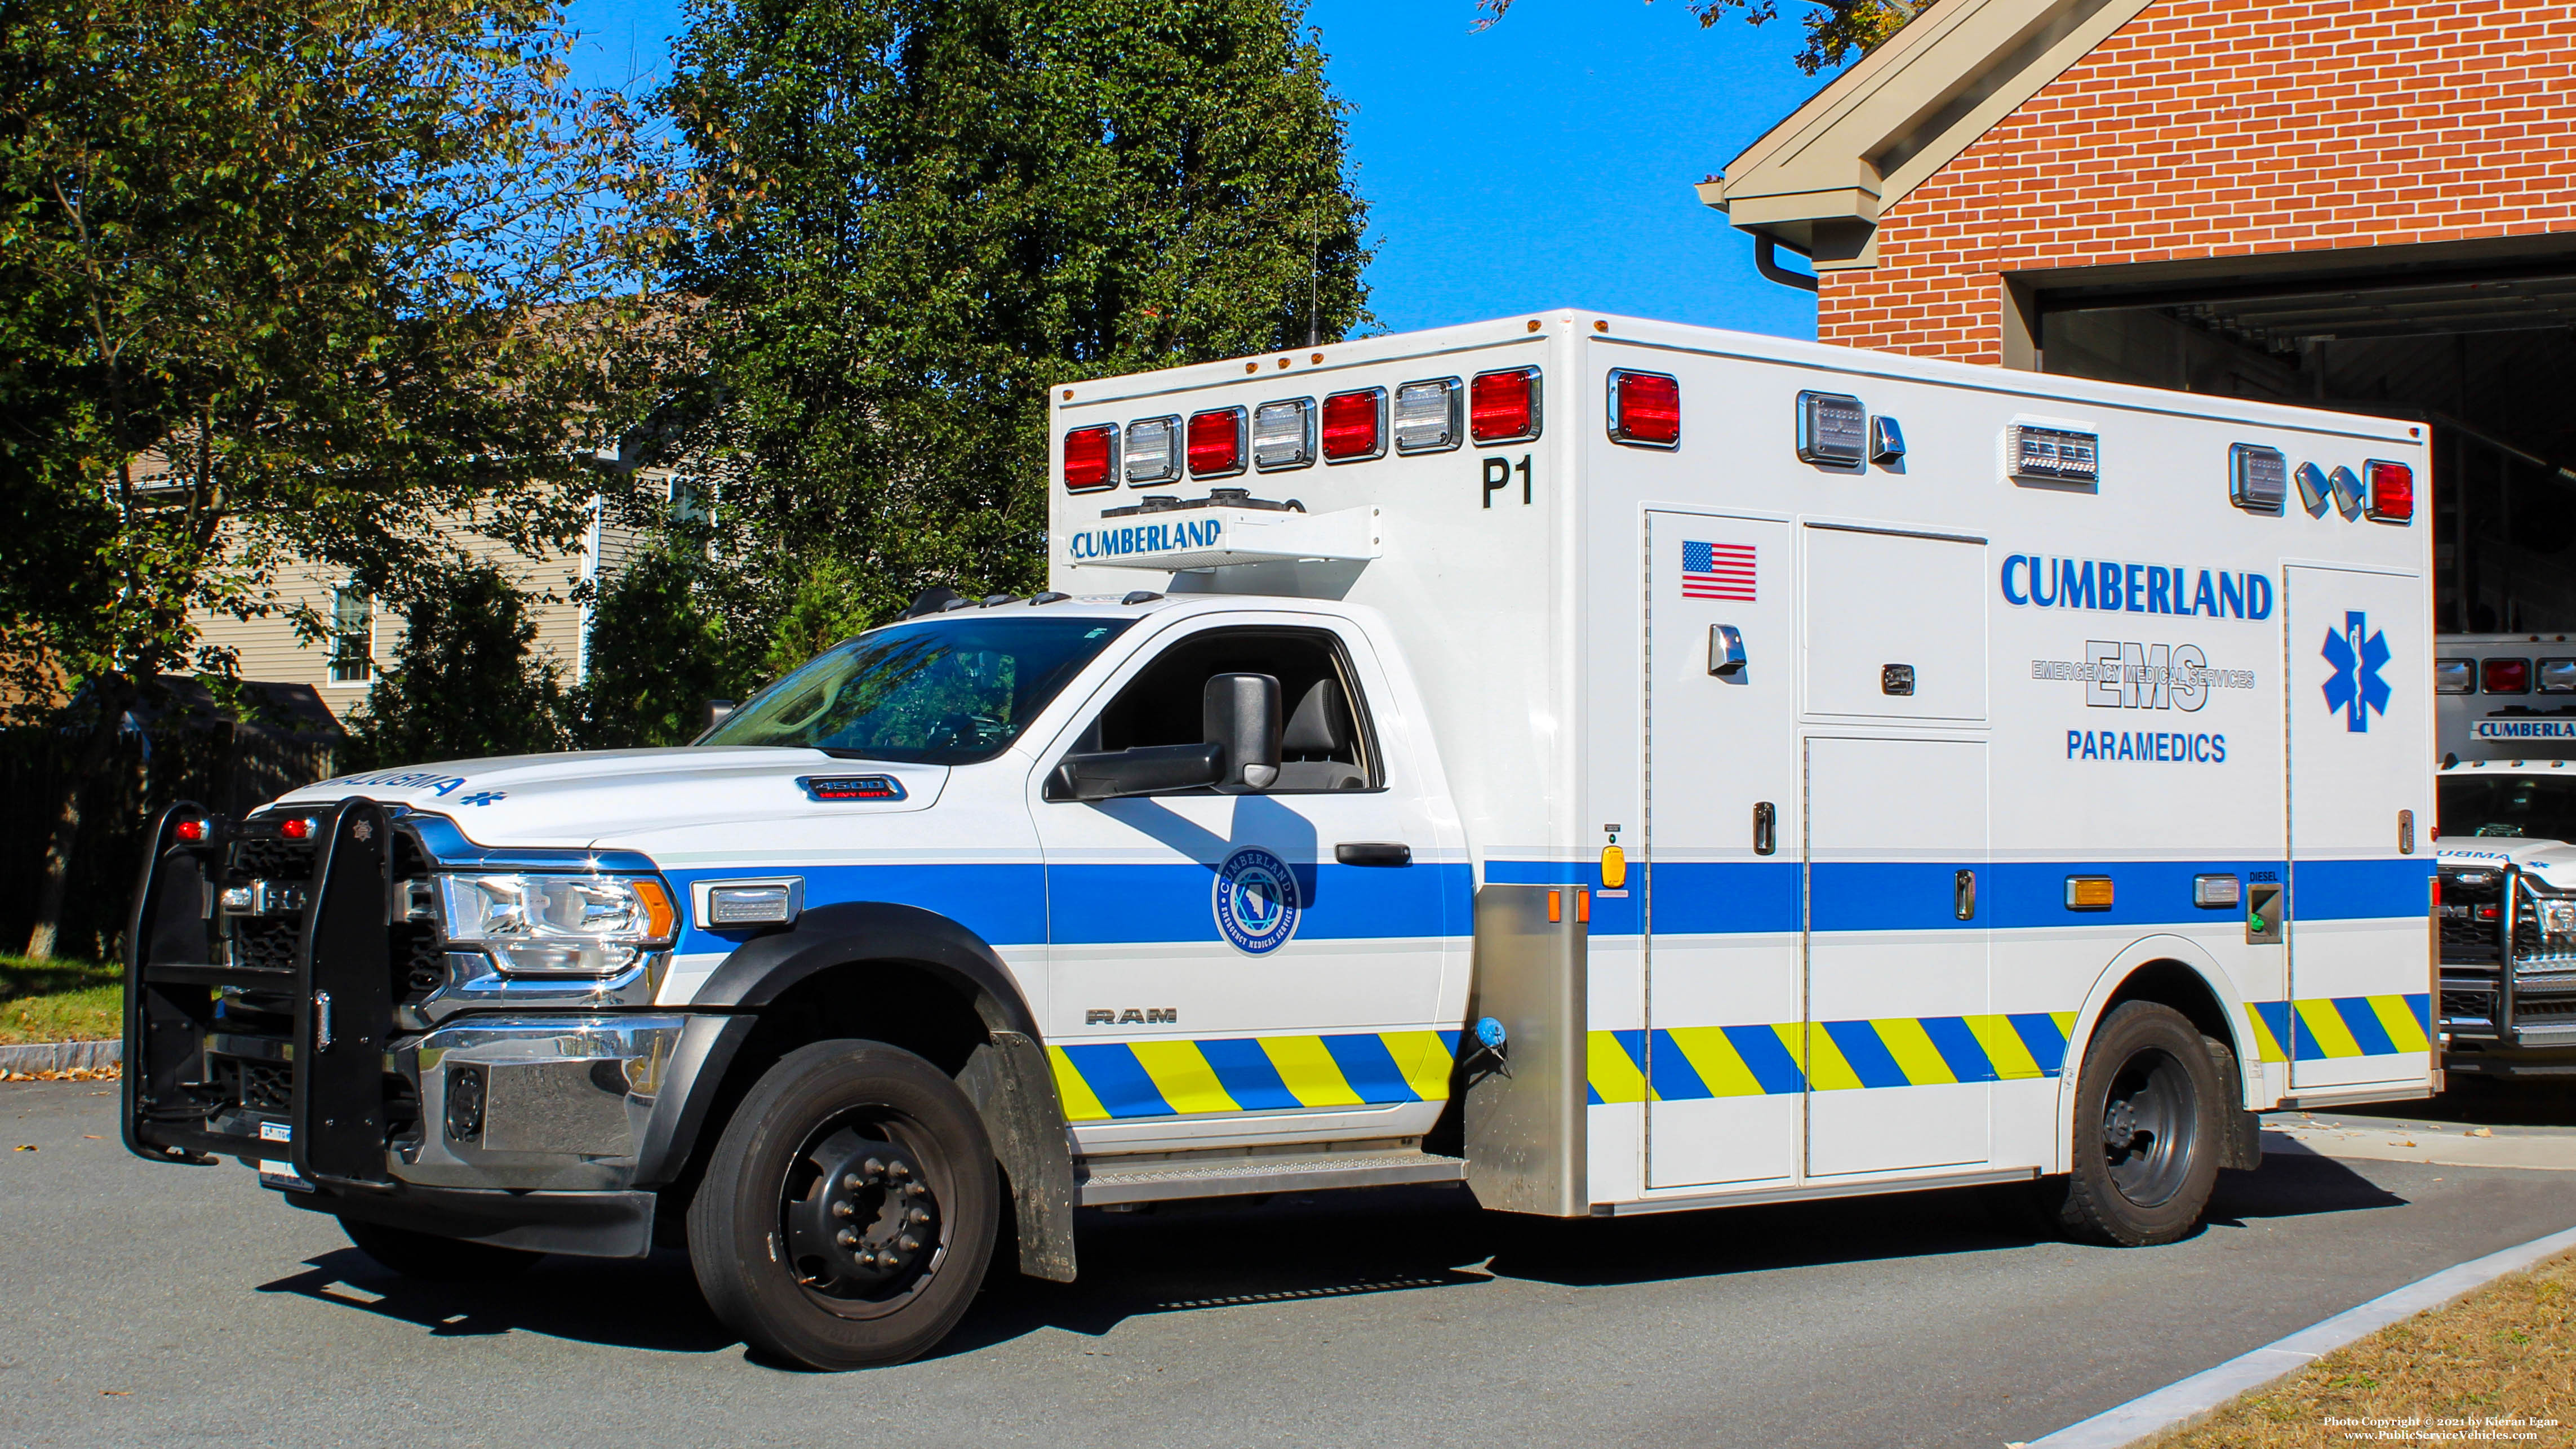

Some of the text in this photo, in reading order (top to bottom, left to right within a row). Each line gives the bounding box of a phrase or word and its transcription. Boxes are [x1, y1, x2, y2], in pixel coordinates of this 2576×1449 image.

[1483, 452, 1531, 509] P1
[1072, 519, 1222, 559] CUMBERLAND
[2001, 554, 2272, 620] CUMBERLAND
[2031, 660, 2254, 688] EMERGENCY MEDICAL SERVICES
[2085, 640, 2208, 712] EMS
[2067, 731, 2226, 763] PARAMEDICS
[816, 781, 885, 790] 4500
[1220, 853, 1291, 892] CUMBERLAND
[2249, 872, 2278, 882] DIESEL
[1221, 905, 1294, 949] EMERGENCY MEDICAL SERVICES
[1085, 1008, 1178, 1025] RAM
